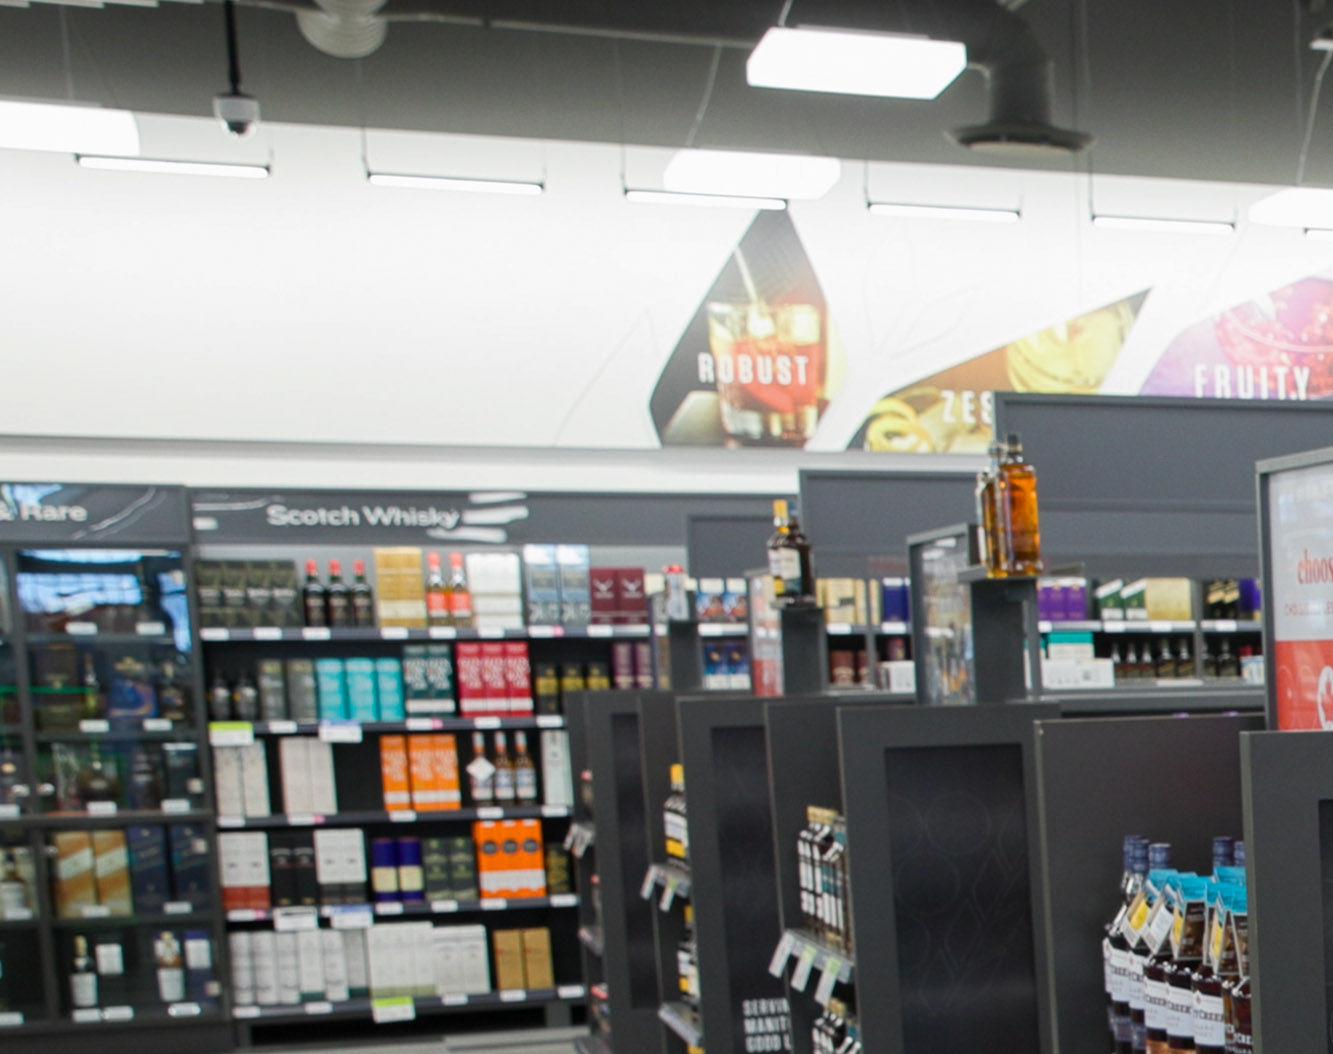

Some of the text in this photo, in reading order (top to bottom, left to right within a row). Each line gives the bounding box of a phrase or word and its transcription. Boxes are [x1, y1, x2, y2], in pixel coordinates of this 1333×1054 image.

[698, 352, 810, 386] ROBUST
[1194, 363, 1311, 400] FRUITY
[25, 504, 87, 521] Rare
[266, 504, 459, 529] Scotch Whisky
